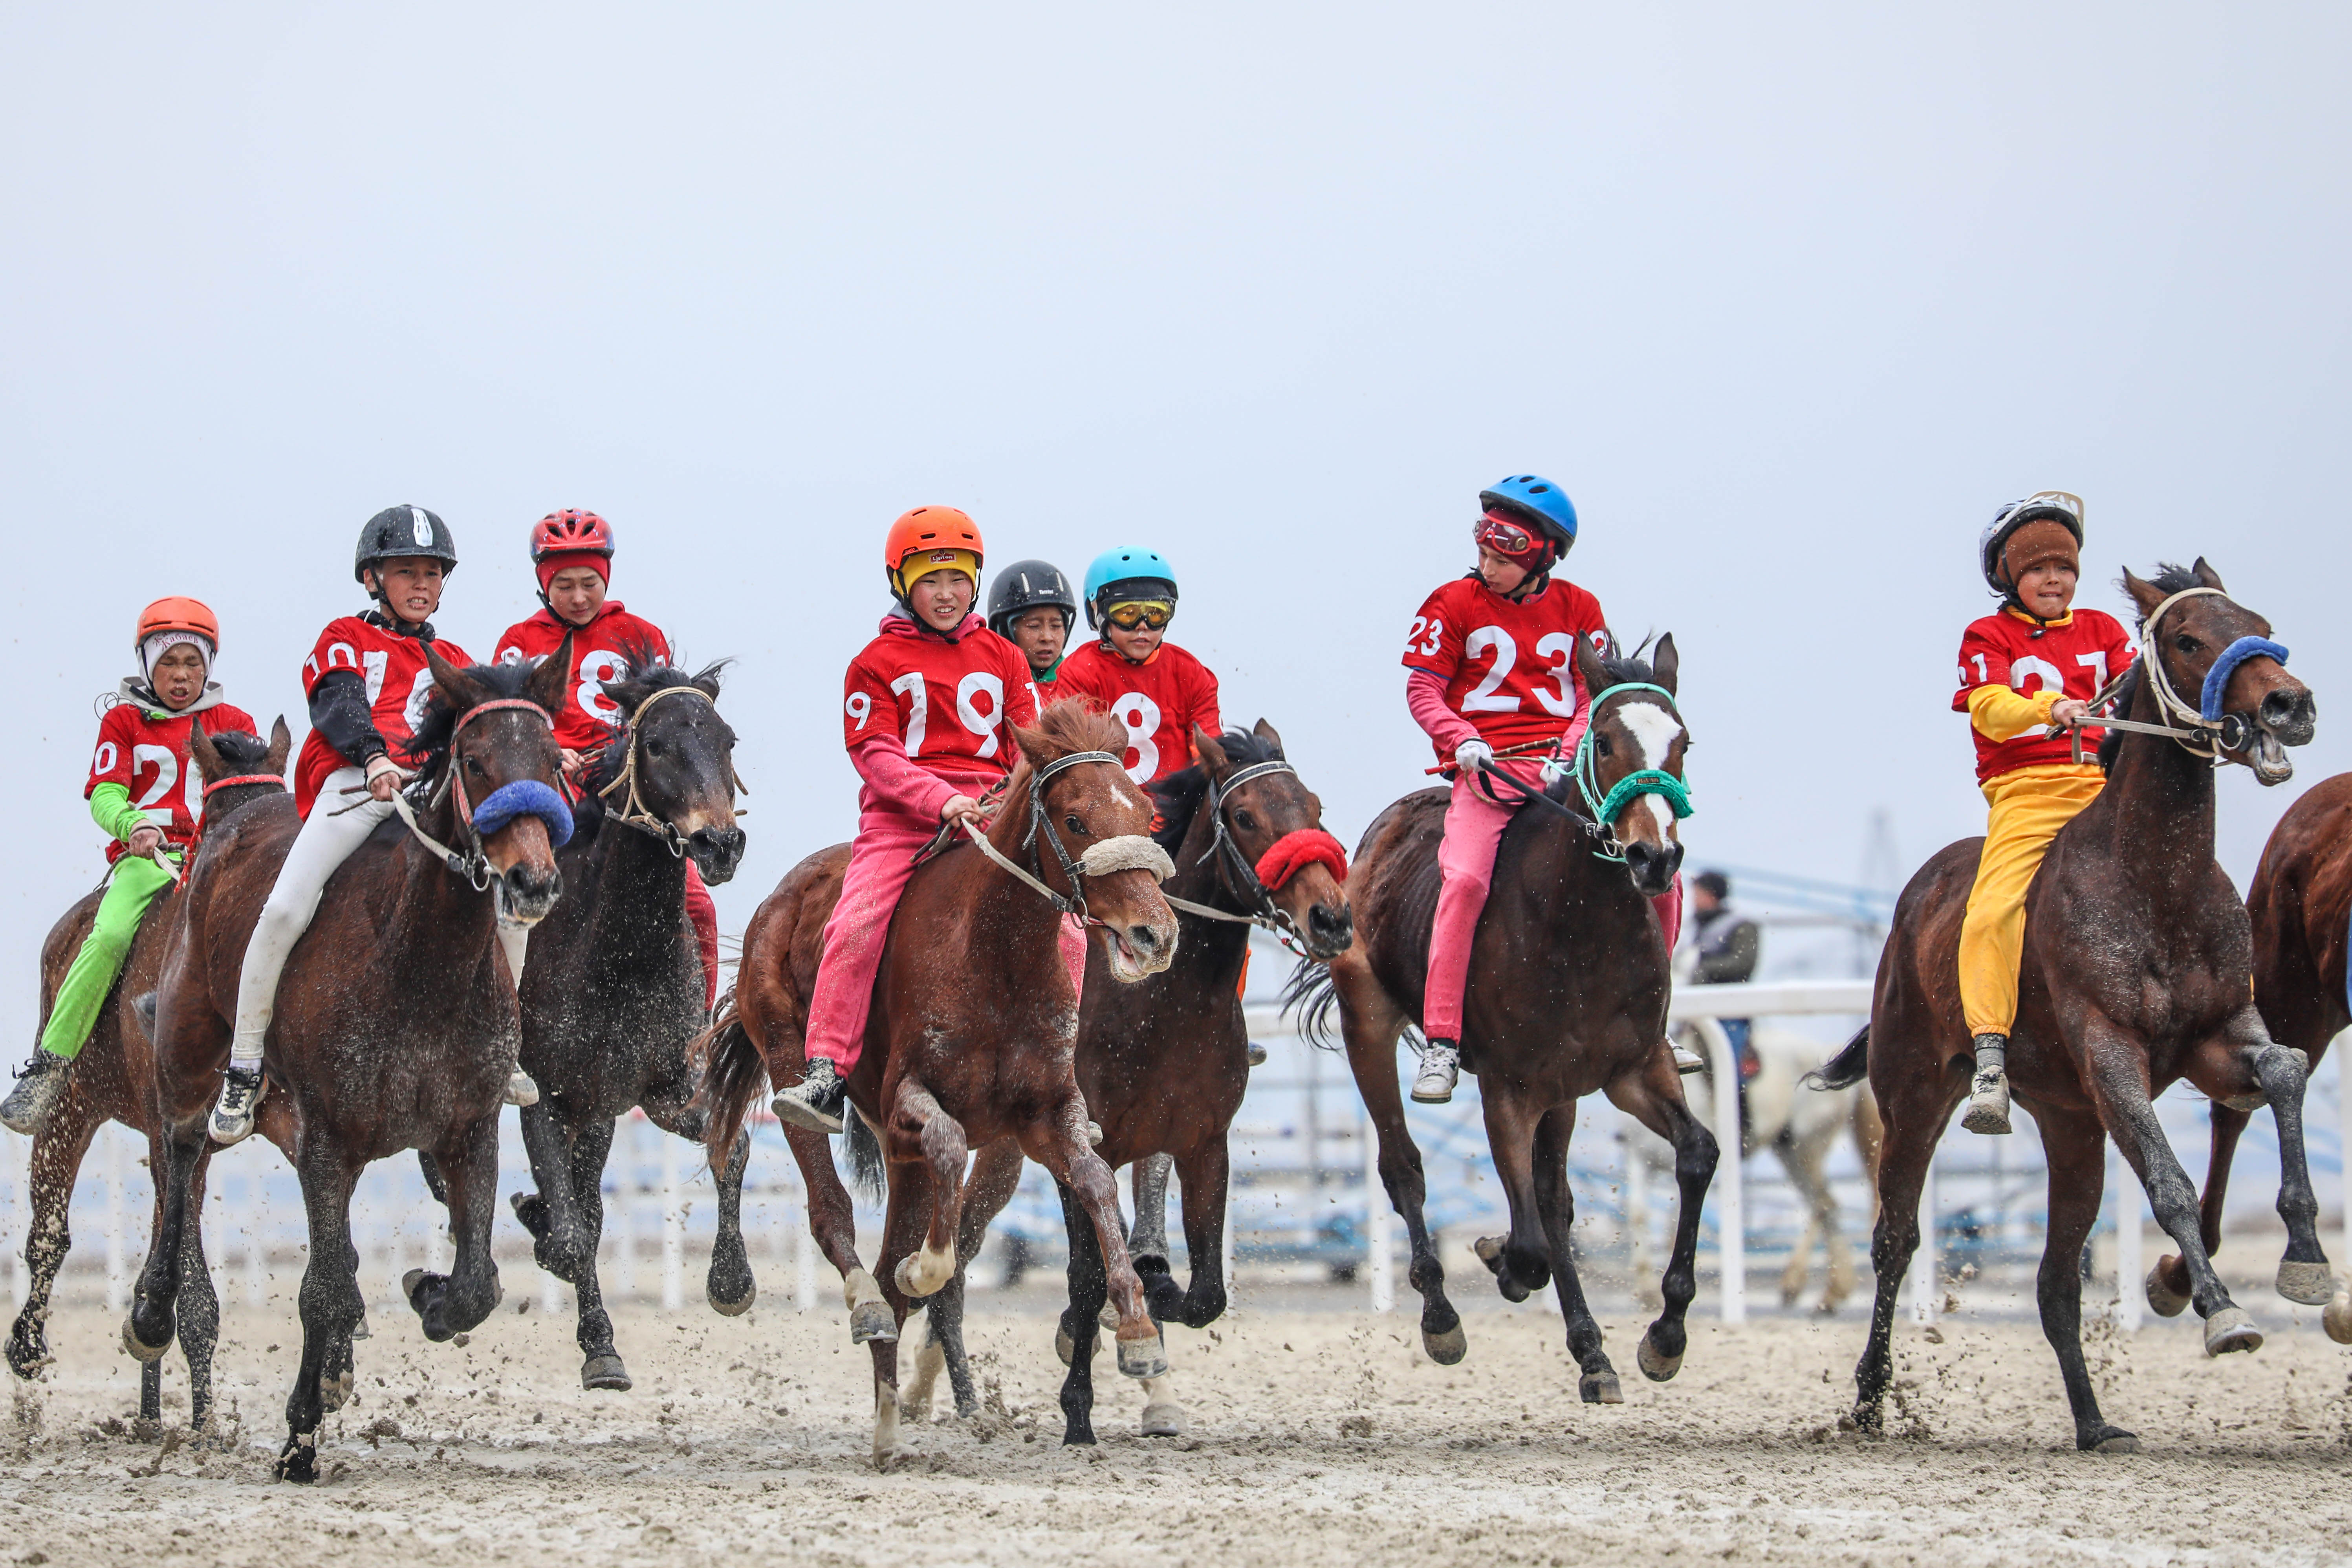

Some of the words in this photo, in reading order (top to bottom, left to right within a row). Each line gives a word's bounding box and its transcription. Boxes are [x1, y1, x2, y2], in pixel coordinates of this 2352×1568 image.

[159, 634, 198, 651] Жабаев
[1405, 615, 1443, 656] 23
[1461, 625, 1576, 718] 23
[845, 691, 871, 731] 9
[890, 672, 1003, 758] 19
[95, 741, 117, 775] 0
